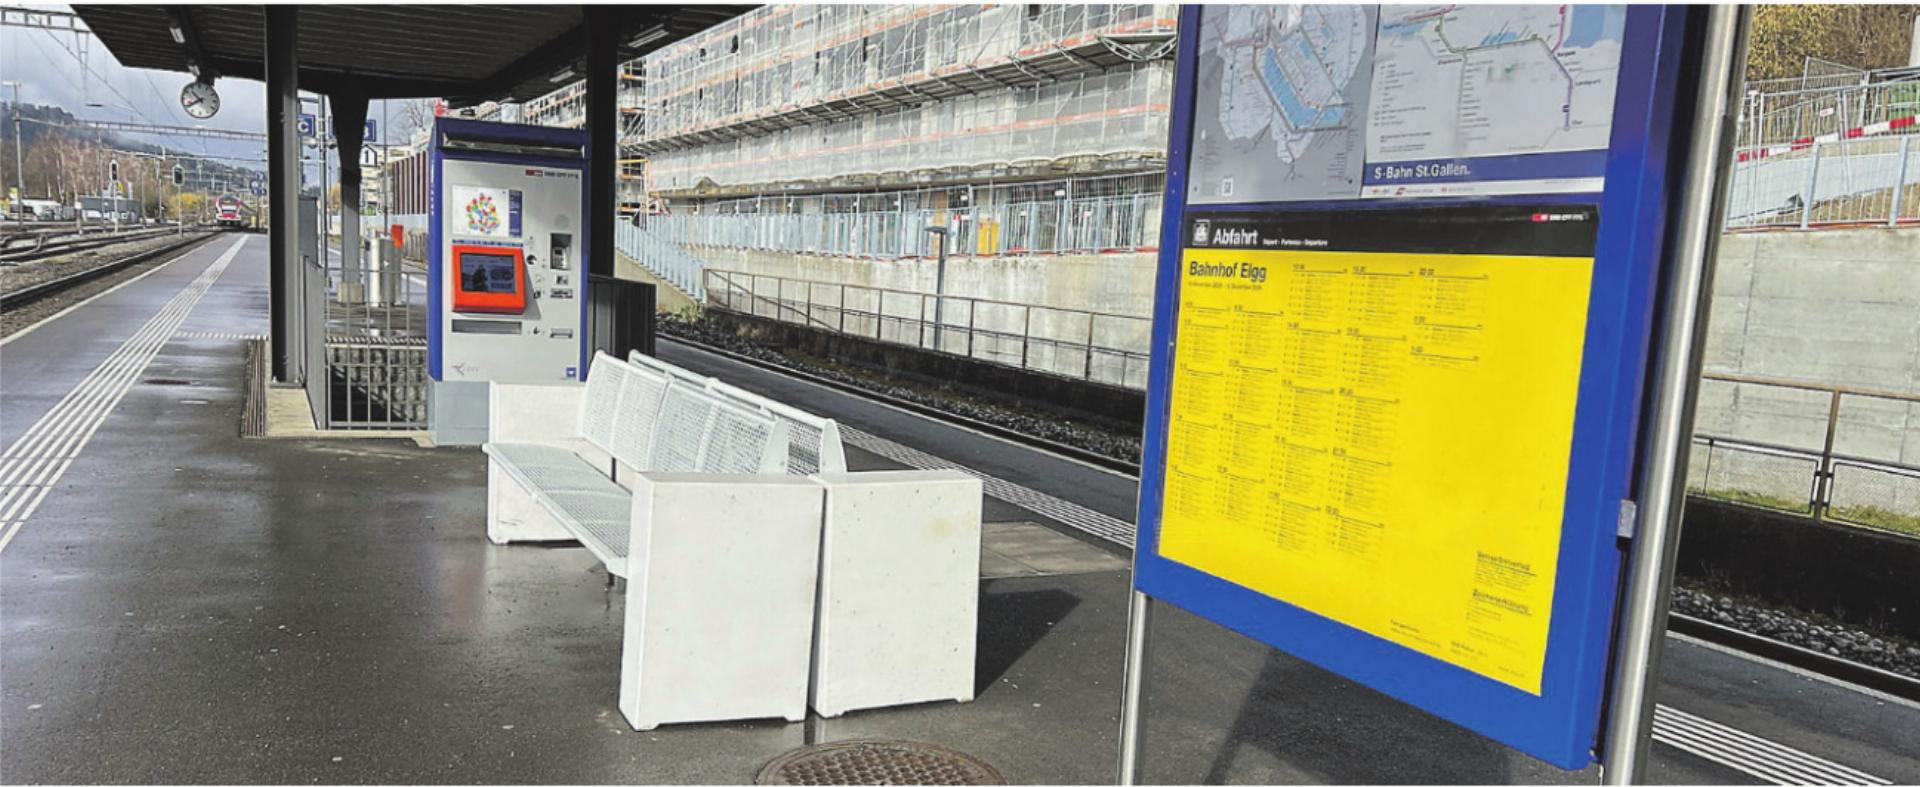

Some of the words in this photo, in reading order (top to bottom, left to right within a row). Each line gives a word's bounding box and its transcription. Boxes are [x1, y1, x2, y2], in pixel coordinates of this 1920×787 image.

[297, 121, 309, 133] C
[364, 150, 369, 163] 1
[1374, 166, 1413, 180] S-Bahn
[1213, 228, 1258, 245] Abfahrt
[1189, 261, 1238, 278] Bahnhof
